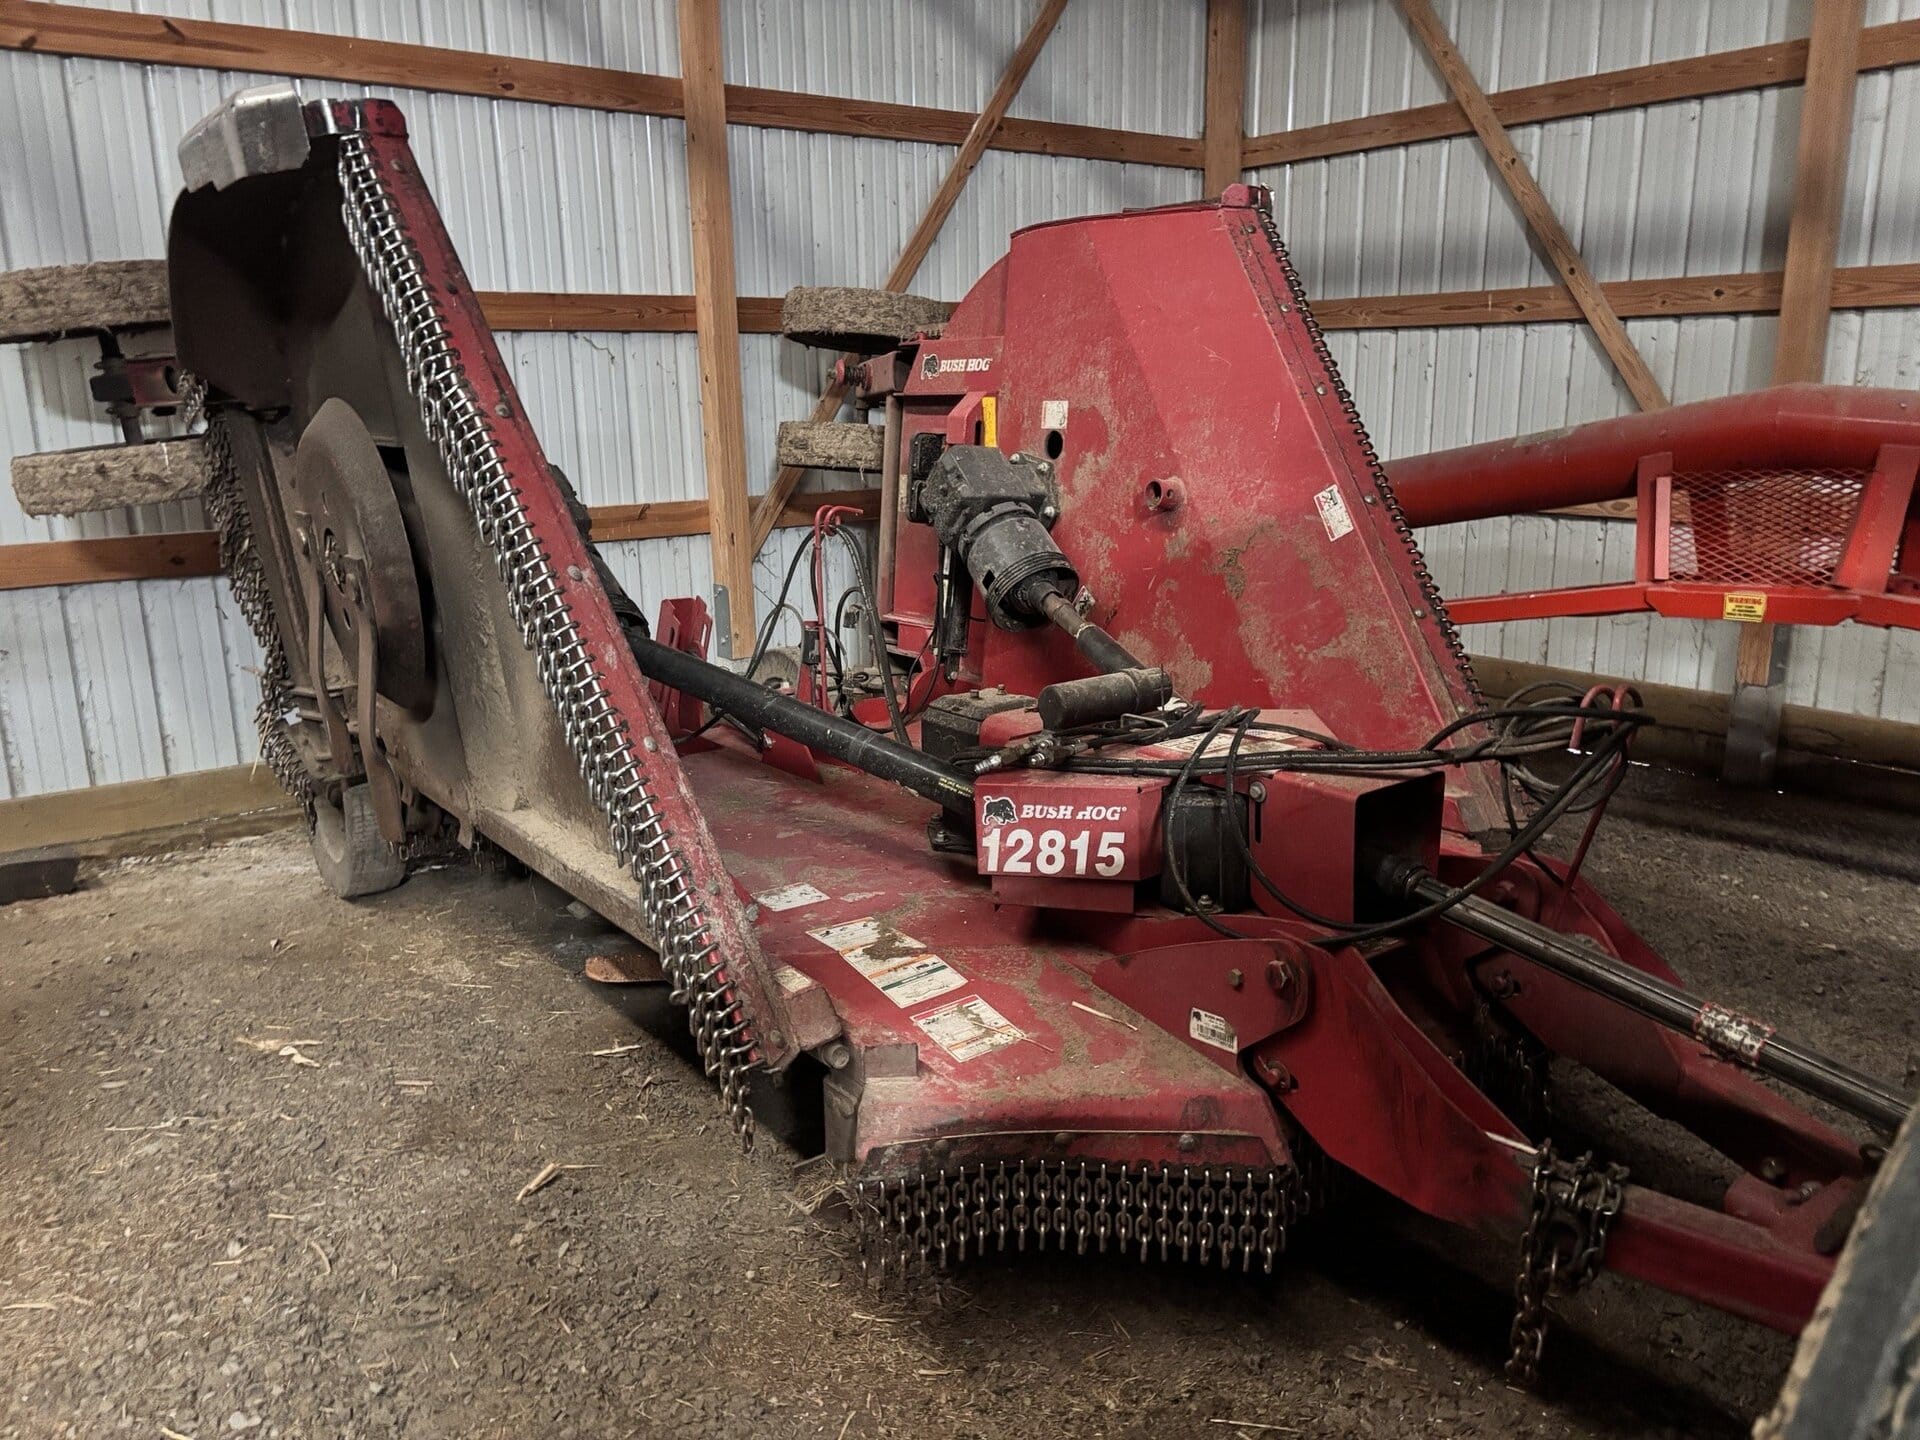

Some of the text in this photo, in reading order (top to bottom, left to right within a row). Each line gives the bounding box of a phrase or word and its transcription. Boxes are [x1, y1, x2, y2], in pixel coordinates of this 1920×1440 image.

[939, 358, 991, 372] BUSH HOG
[1020, 804, 1074, 819] BUSH
[982, 828, 1125, 877] 12815
